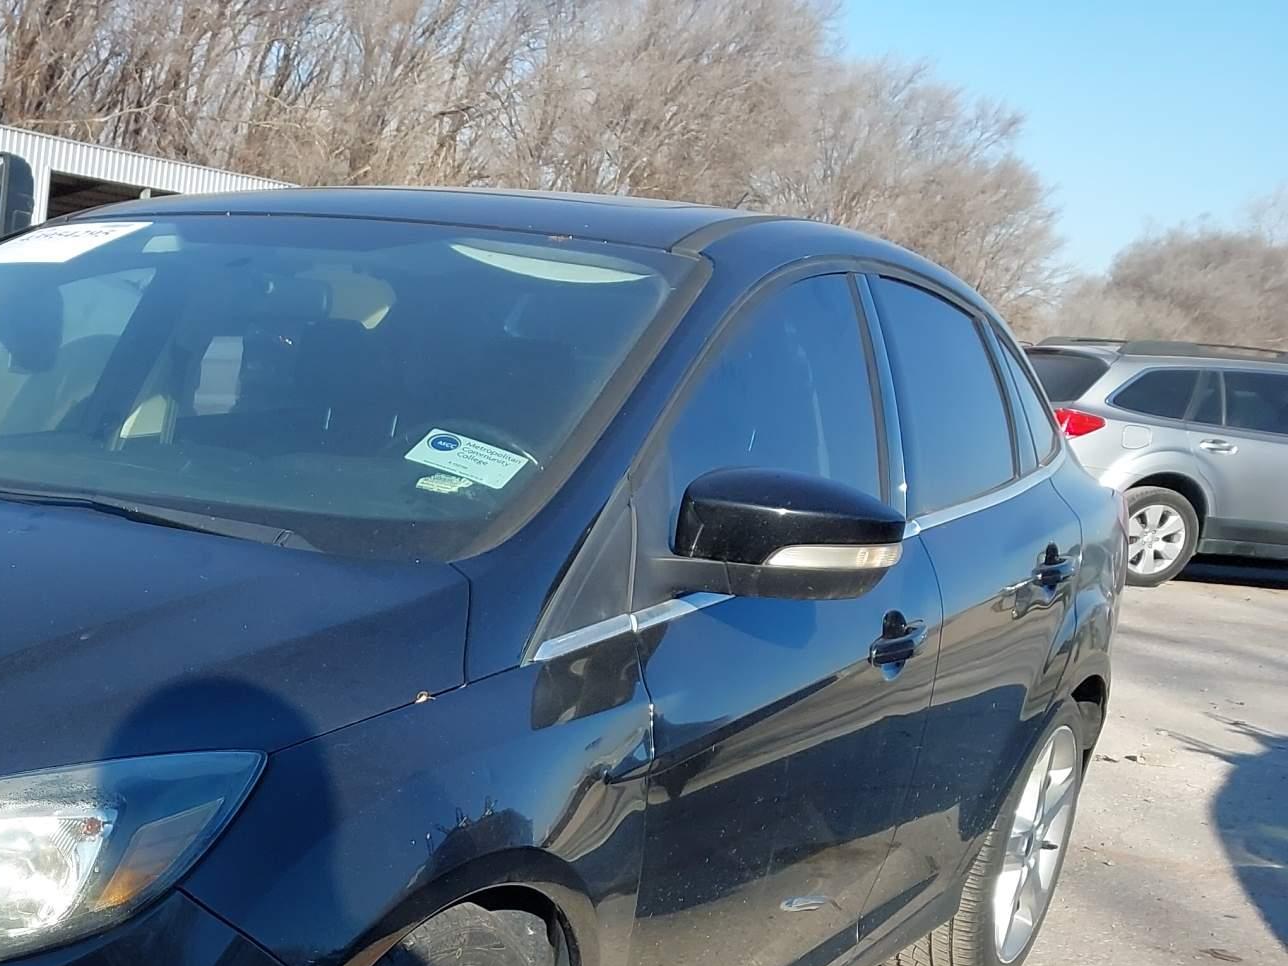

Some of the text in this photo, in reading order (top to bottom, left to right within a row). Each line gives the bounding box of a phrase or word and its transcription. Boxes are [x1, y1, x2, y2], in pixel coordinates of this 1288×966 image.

[456, 451, 489, 466] College
[462, 446, 510, 467] Community
[466, 441, 522, 464] Metropolitan
